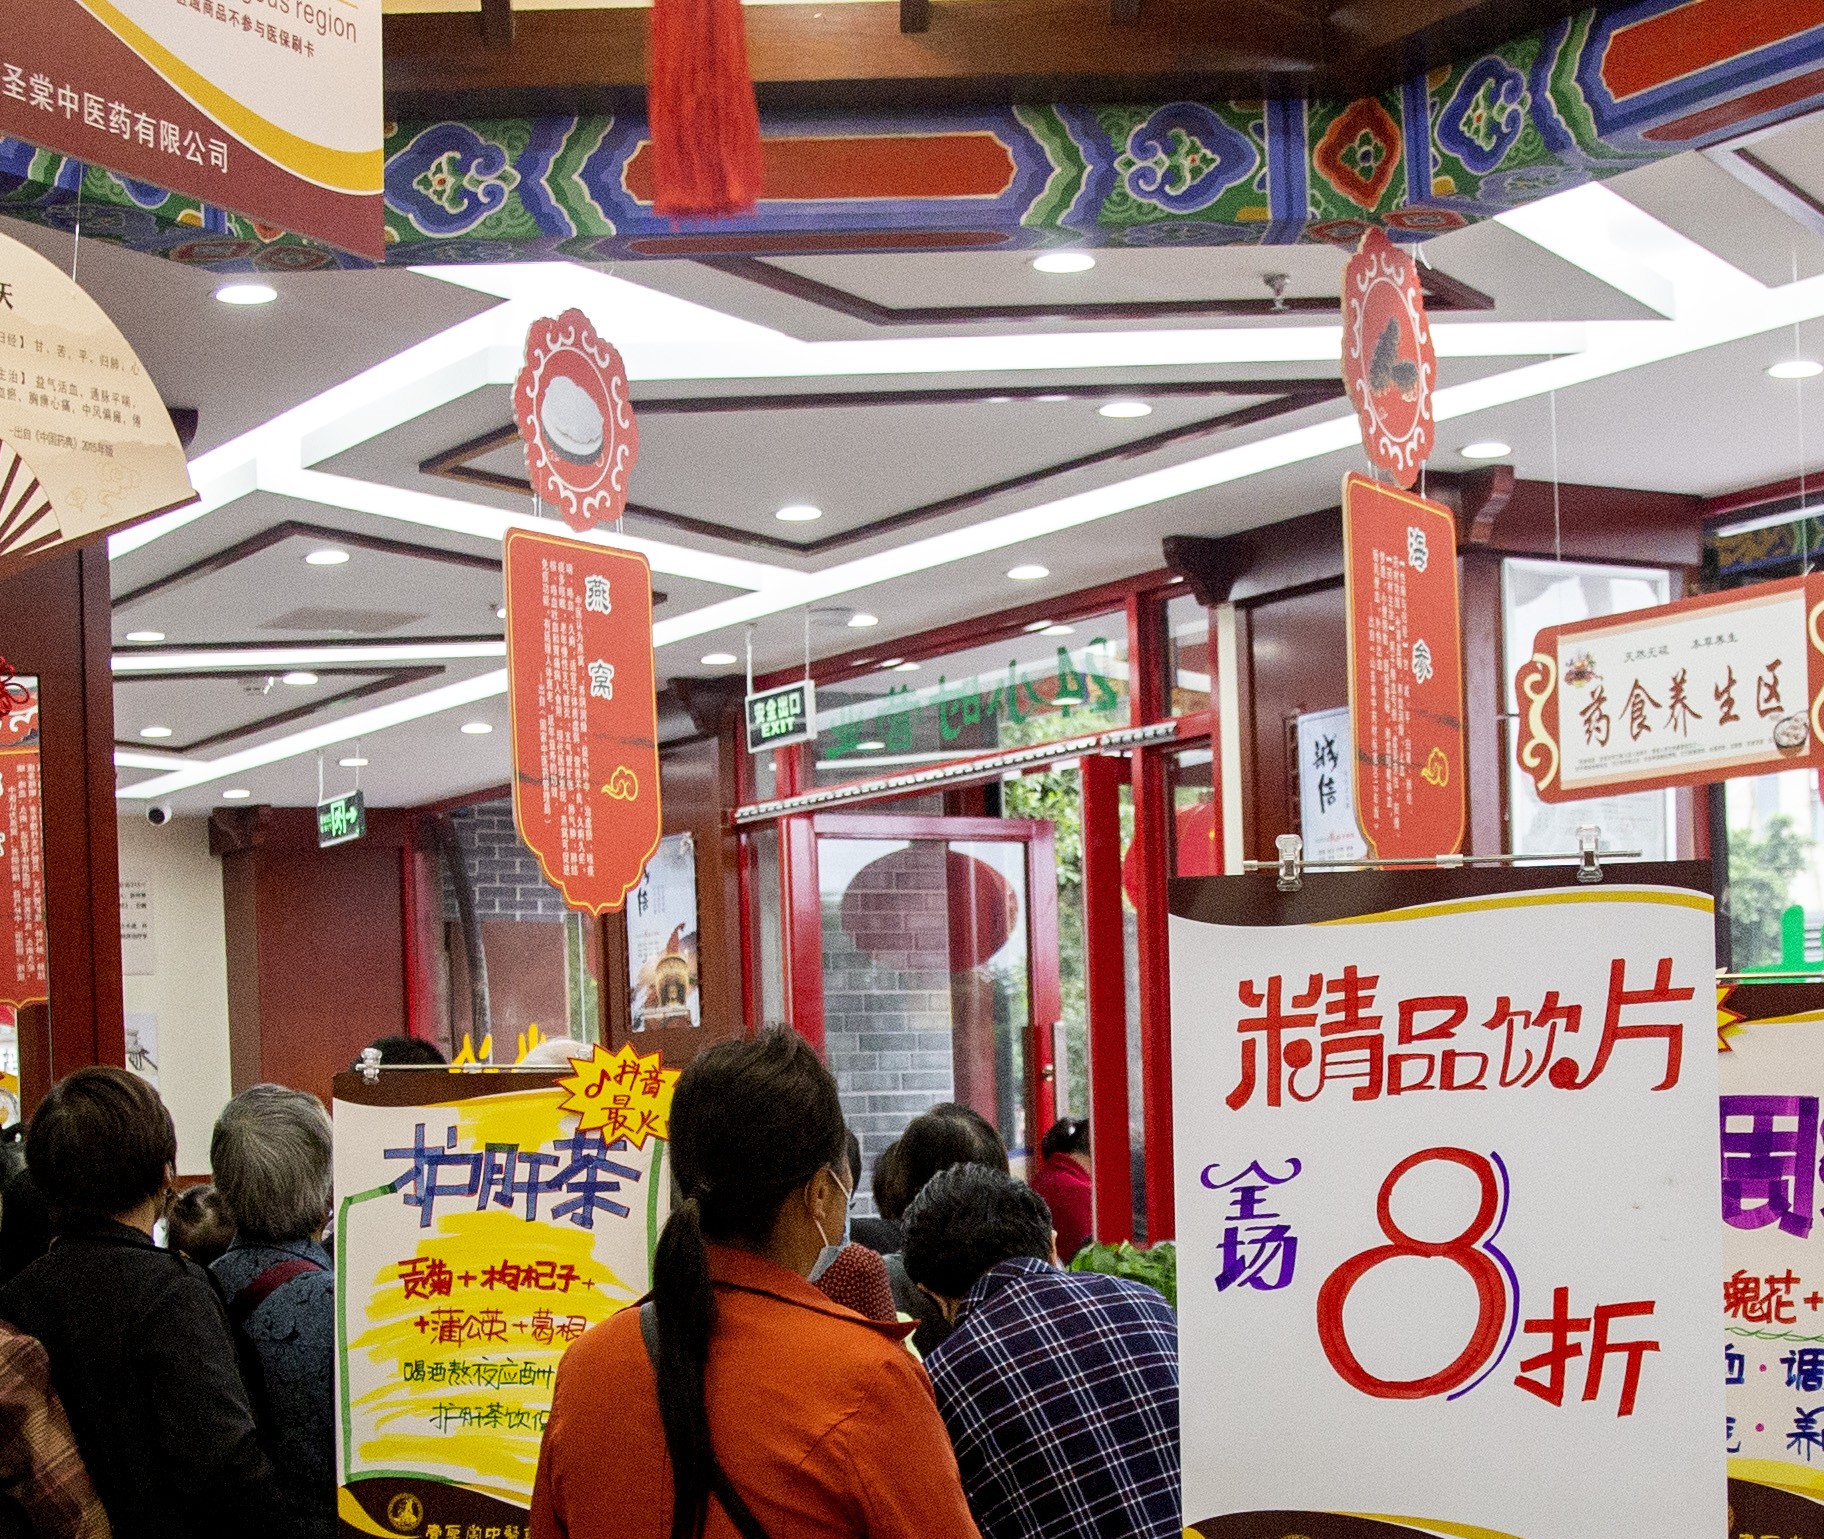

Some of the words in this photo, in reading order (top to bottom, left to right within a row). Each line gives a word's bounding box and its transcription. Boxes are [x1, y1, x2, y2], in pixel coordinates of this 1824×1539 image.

[293, 0, 358, 43] region
[585, 575, 615, 700] 燕窝
[753, 691, 801, 723] 安全出口
[761, 720, 794, 738] EXIT
[1579, 658, 1785, 748] 药食养生区
[1226, 957, 1694, 1111] 精品饮片
[612, 1059, 667, 1100] 抖音
[601, 1094, 661, 1135] 最火
[384, 1123, 643, 1229] 护肝茶
[1200, 1157, 1301, 1291] 全场
